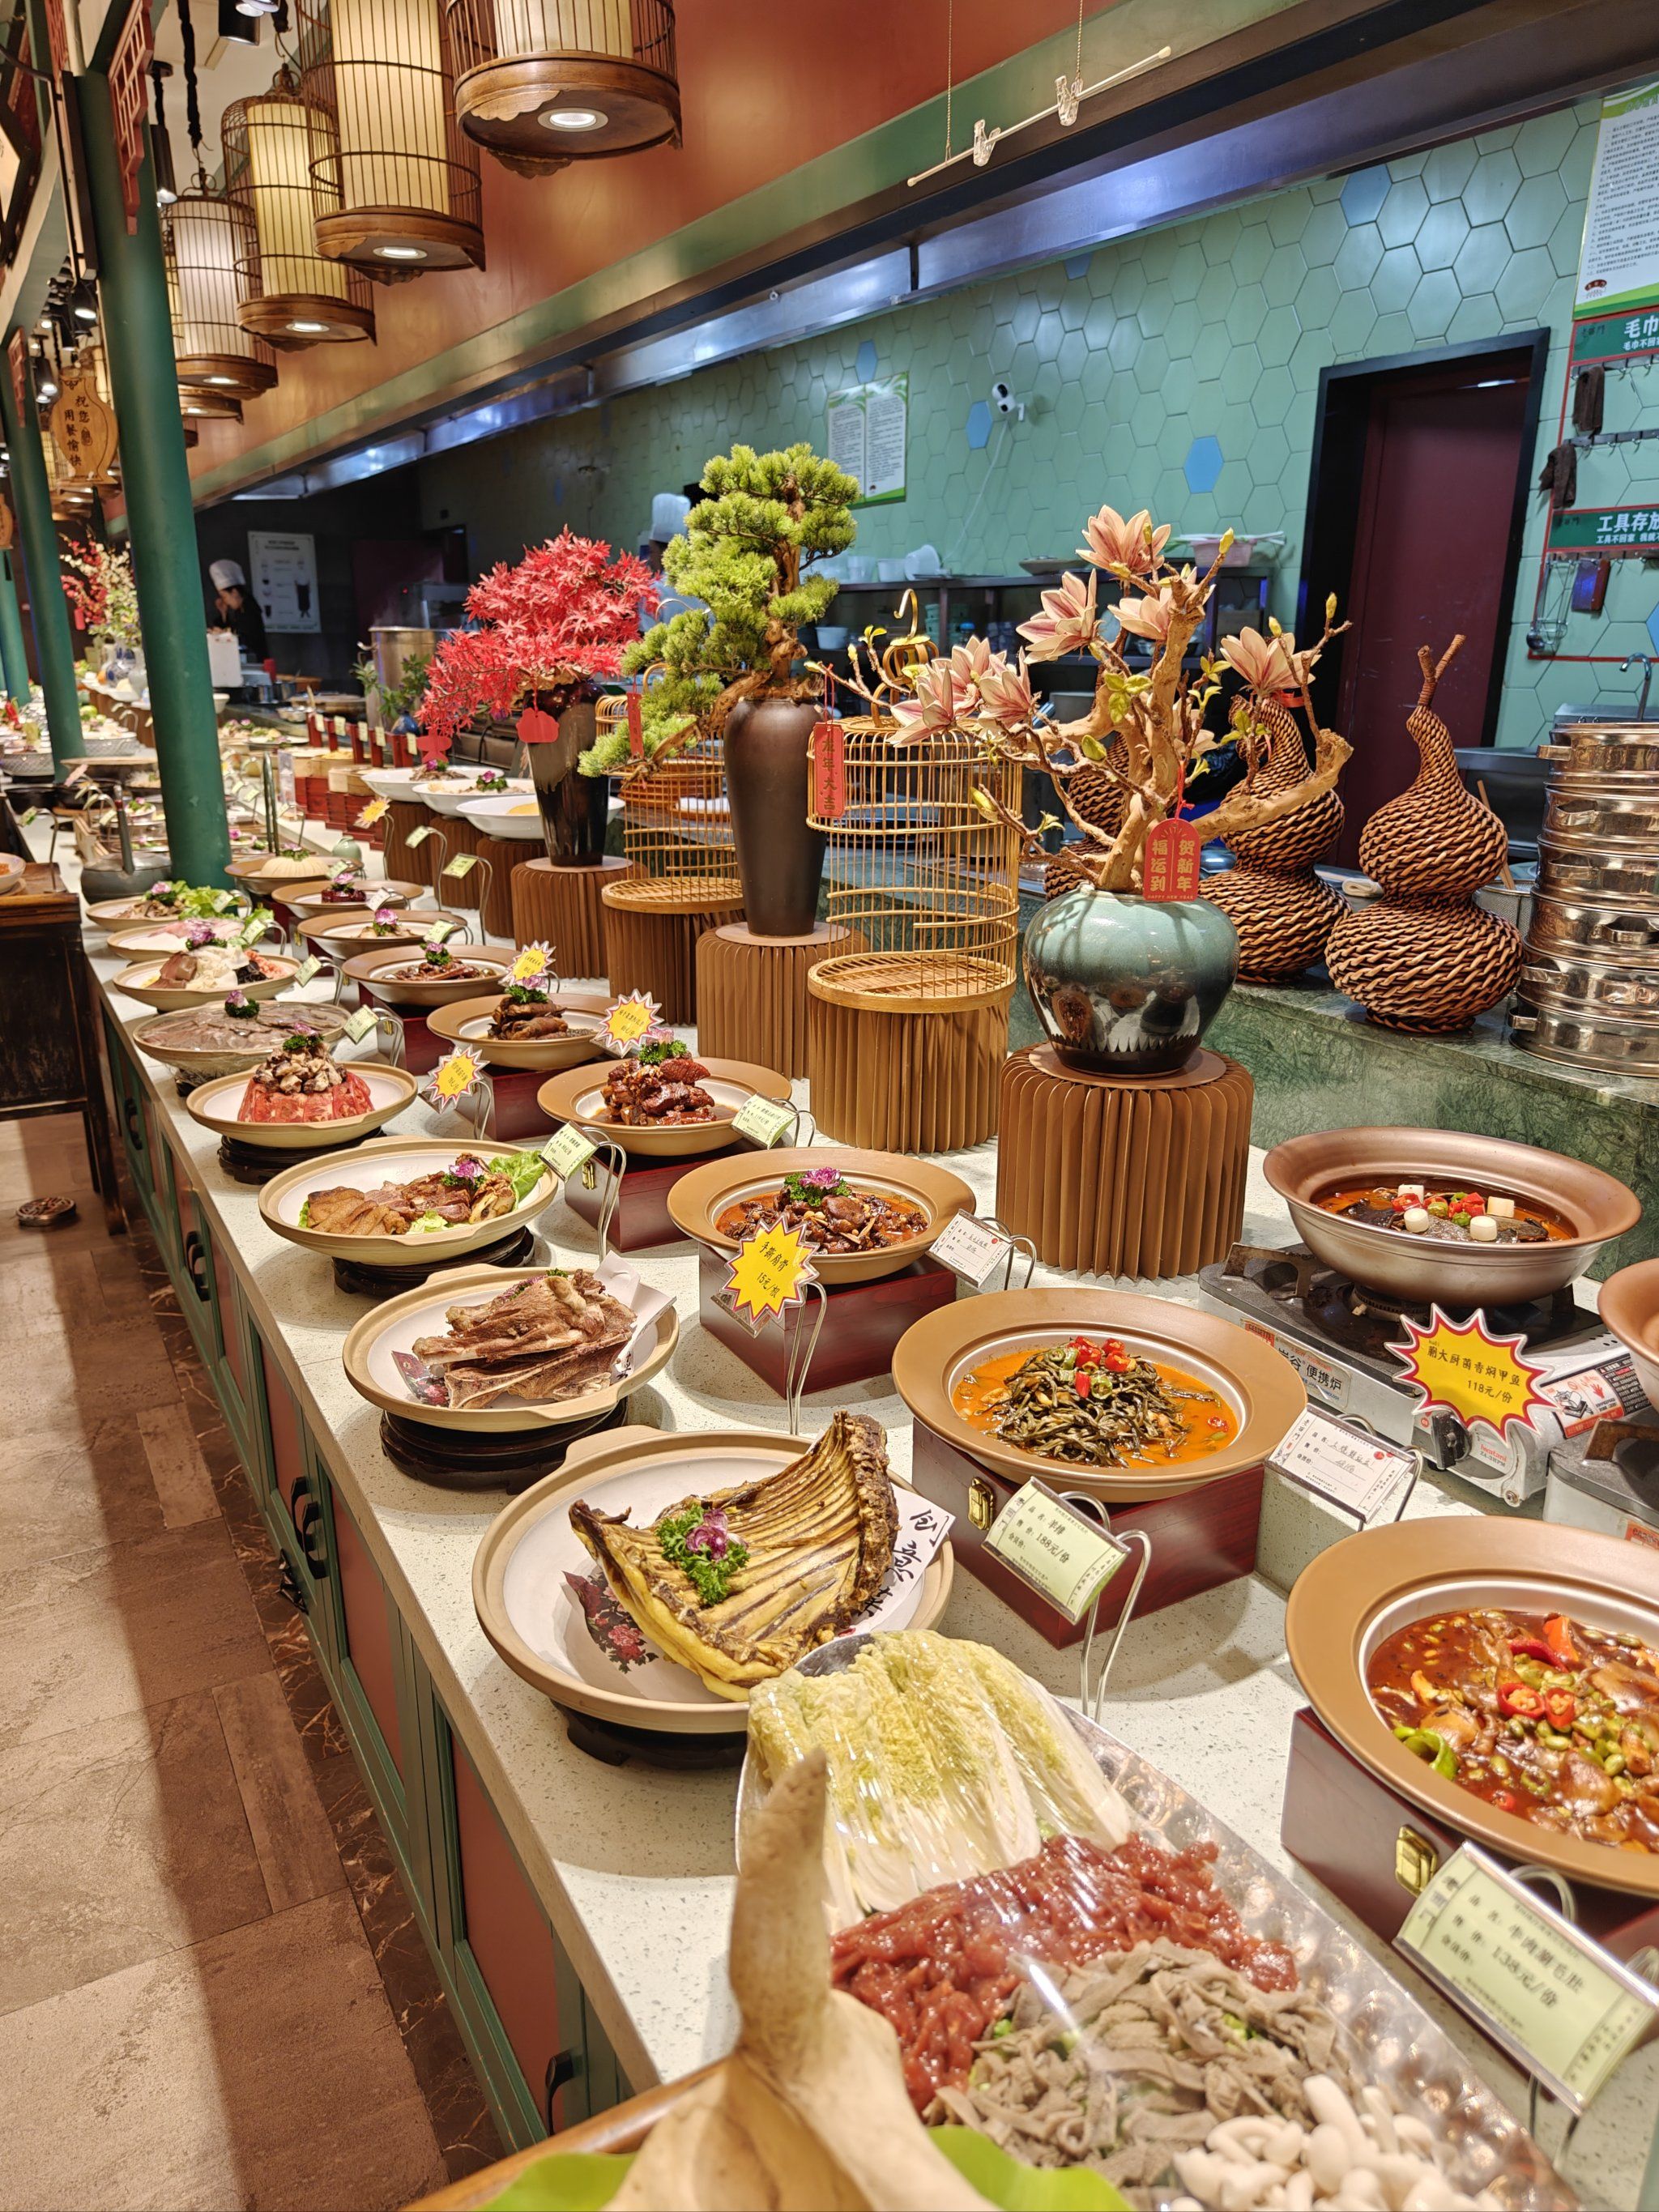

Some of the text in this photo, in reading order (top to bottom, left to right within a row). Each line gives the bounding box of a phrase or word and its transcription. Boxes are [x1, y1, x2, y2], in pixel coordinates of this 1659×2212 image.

[1623, 315, 1659, 339] 毛巾
[75, 395, 91, 423] 祝您
[64, 409, 82, 467] 用餐愉快
[1597, 511, 1659, 533] 工具存放
[821, 738, 838, 810] 龙年大吉
[1150, 839, 1168, 892] 福运到
[1177, 839, 1195, 892] 贺新年
[1306, 1364, 1342, 1391] 便携炉
[1468, 1379, 1513, 1404] 118元/份
[1480, 1443, 1508, 1462] Iwatani
[1048, 1519, 1066, 1536] 羊排
[1036, 1534, 1070, 1564] 188元/份
[1491, 1945, 1559, 2009] 138元/份
